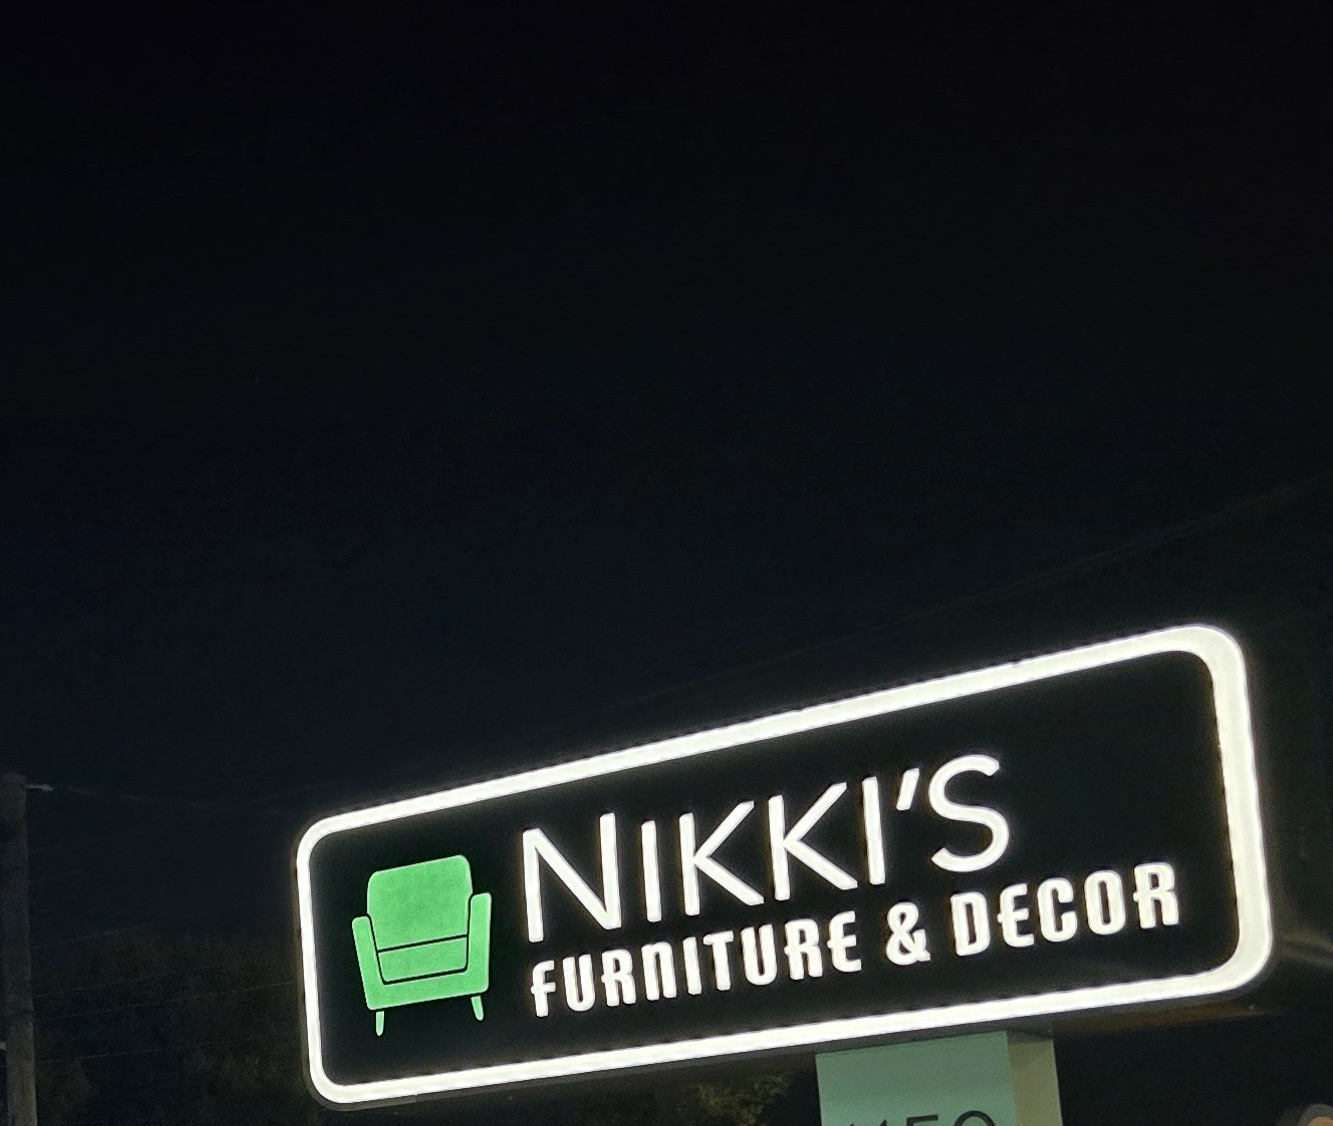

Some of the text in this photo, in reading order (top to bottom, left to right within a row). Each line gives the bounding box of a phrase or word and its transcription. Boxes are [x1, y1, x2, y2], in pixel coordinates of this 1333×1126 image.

[521, 753, 1011, 943] NIKKI'S
[530, 861, 1180, 1018] FURNITURE & DECOR
